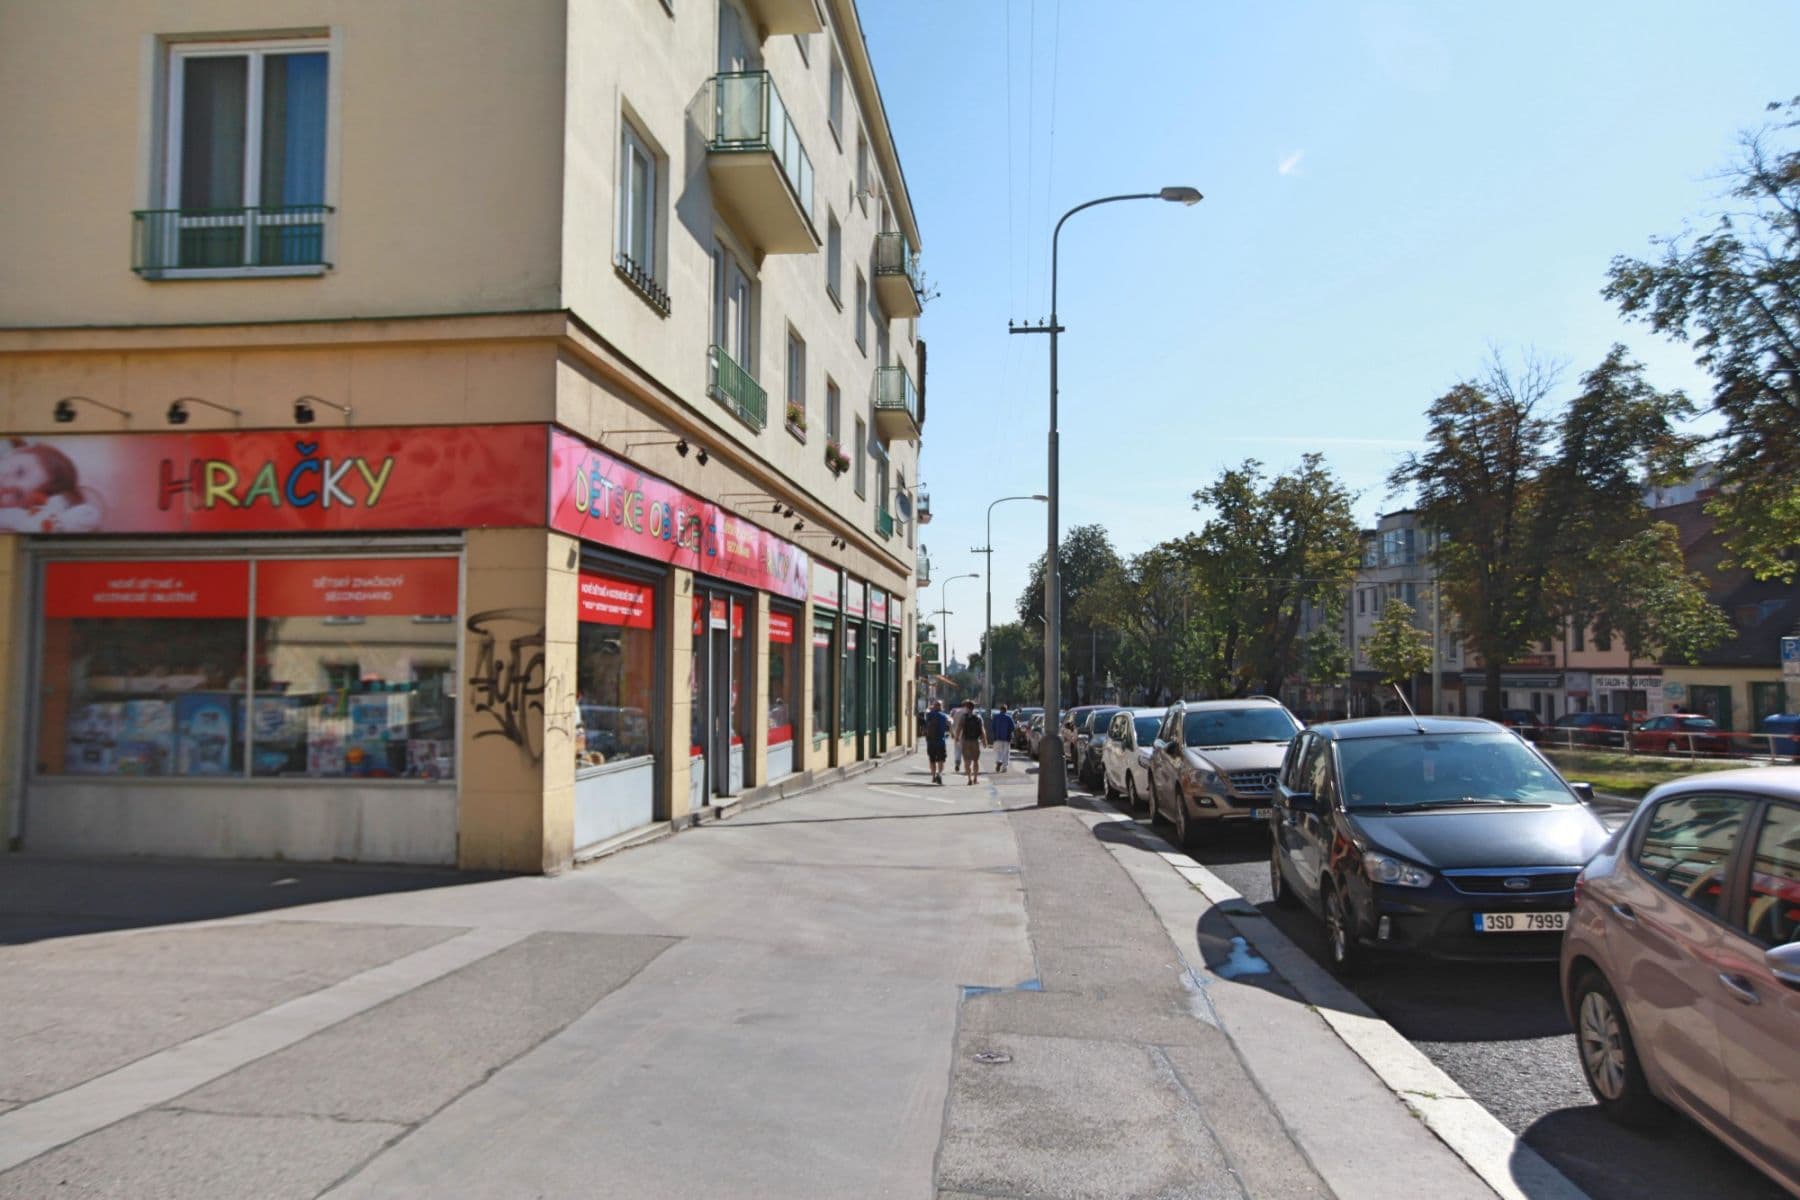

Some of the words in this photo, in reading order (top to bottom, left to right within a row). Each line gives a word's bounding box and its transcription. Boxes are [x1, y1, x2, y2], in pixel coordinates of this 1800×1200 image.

[158, 441, 393, 511] HRAČKY
[575, 458, 644, 535] DĚTSKÉ
[1486, 915, 1514, 930] 3SD
[1526, 914, 1564, 929] 7999
